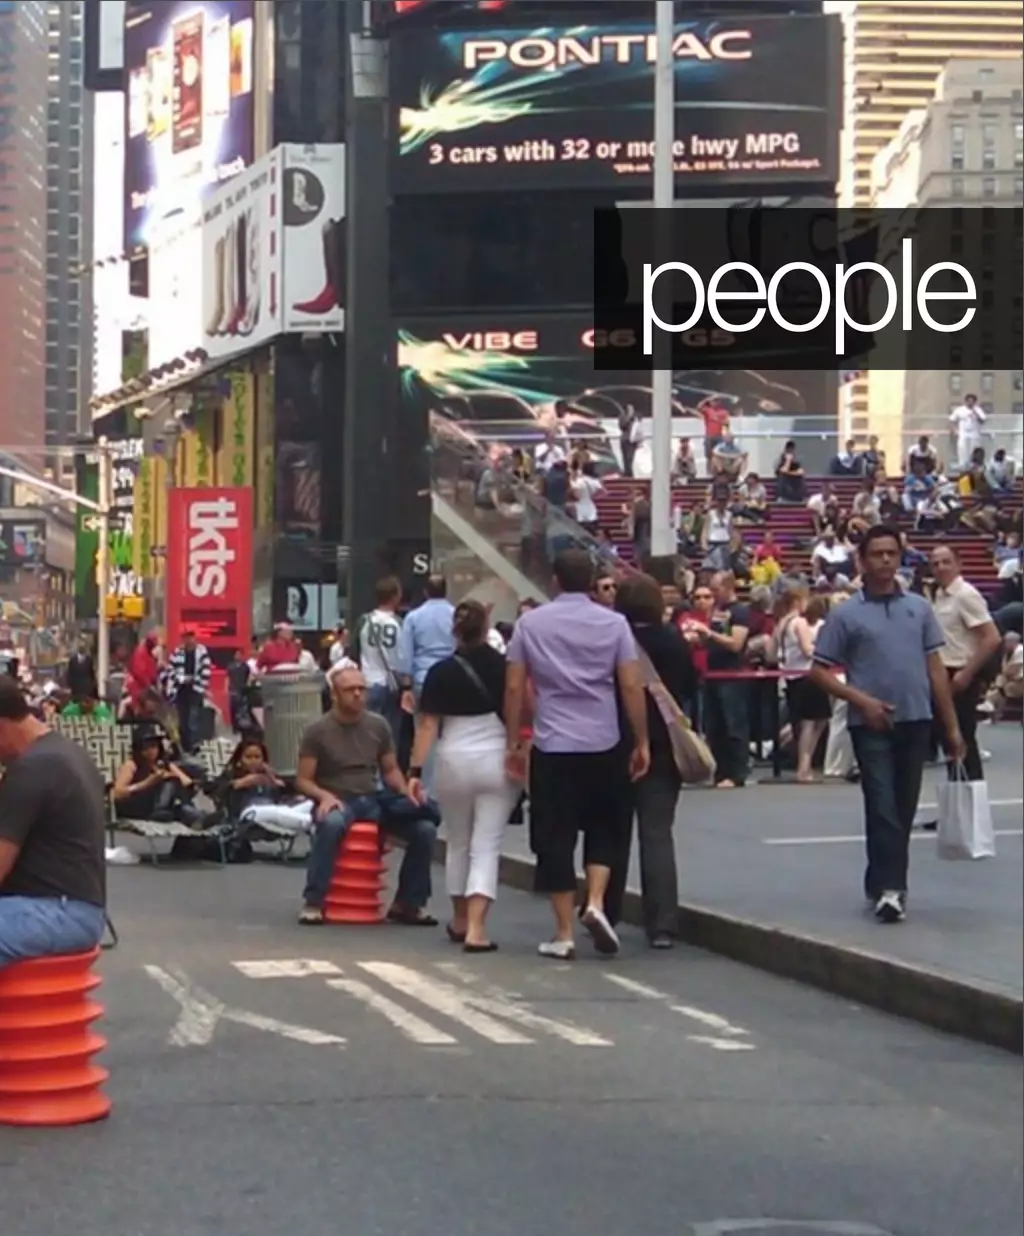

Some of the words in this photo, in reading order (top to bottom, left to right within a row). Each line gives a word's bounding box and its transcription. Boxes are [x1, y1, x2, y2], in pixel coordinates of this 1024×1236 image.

[463, 31, 753, 69] PONTIAC
[429, 143, 444, 164] 3
[449, 144, 498, 163] cars
[504, 140, 555, 162] with
[561, 139, 590, 160] 32
[596, 142, 622, 159] or
[627, 139, 685, 158] moe
[691, 134, 740, 159] hwy
[745, 132, 801, 154] MPG
[443, 331, 538, 350] VIBE
[581, 329, 637, 347] G6
[682, 329, 736, 347] G5
[188, 496, 239, 598] tkts
[367, 622, 397, 649] 89
